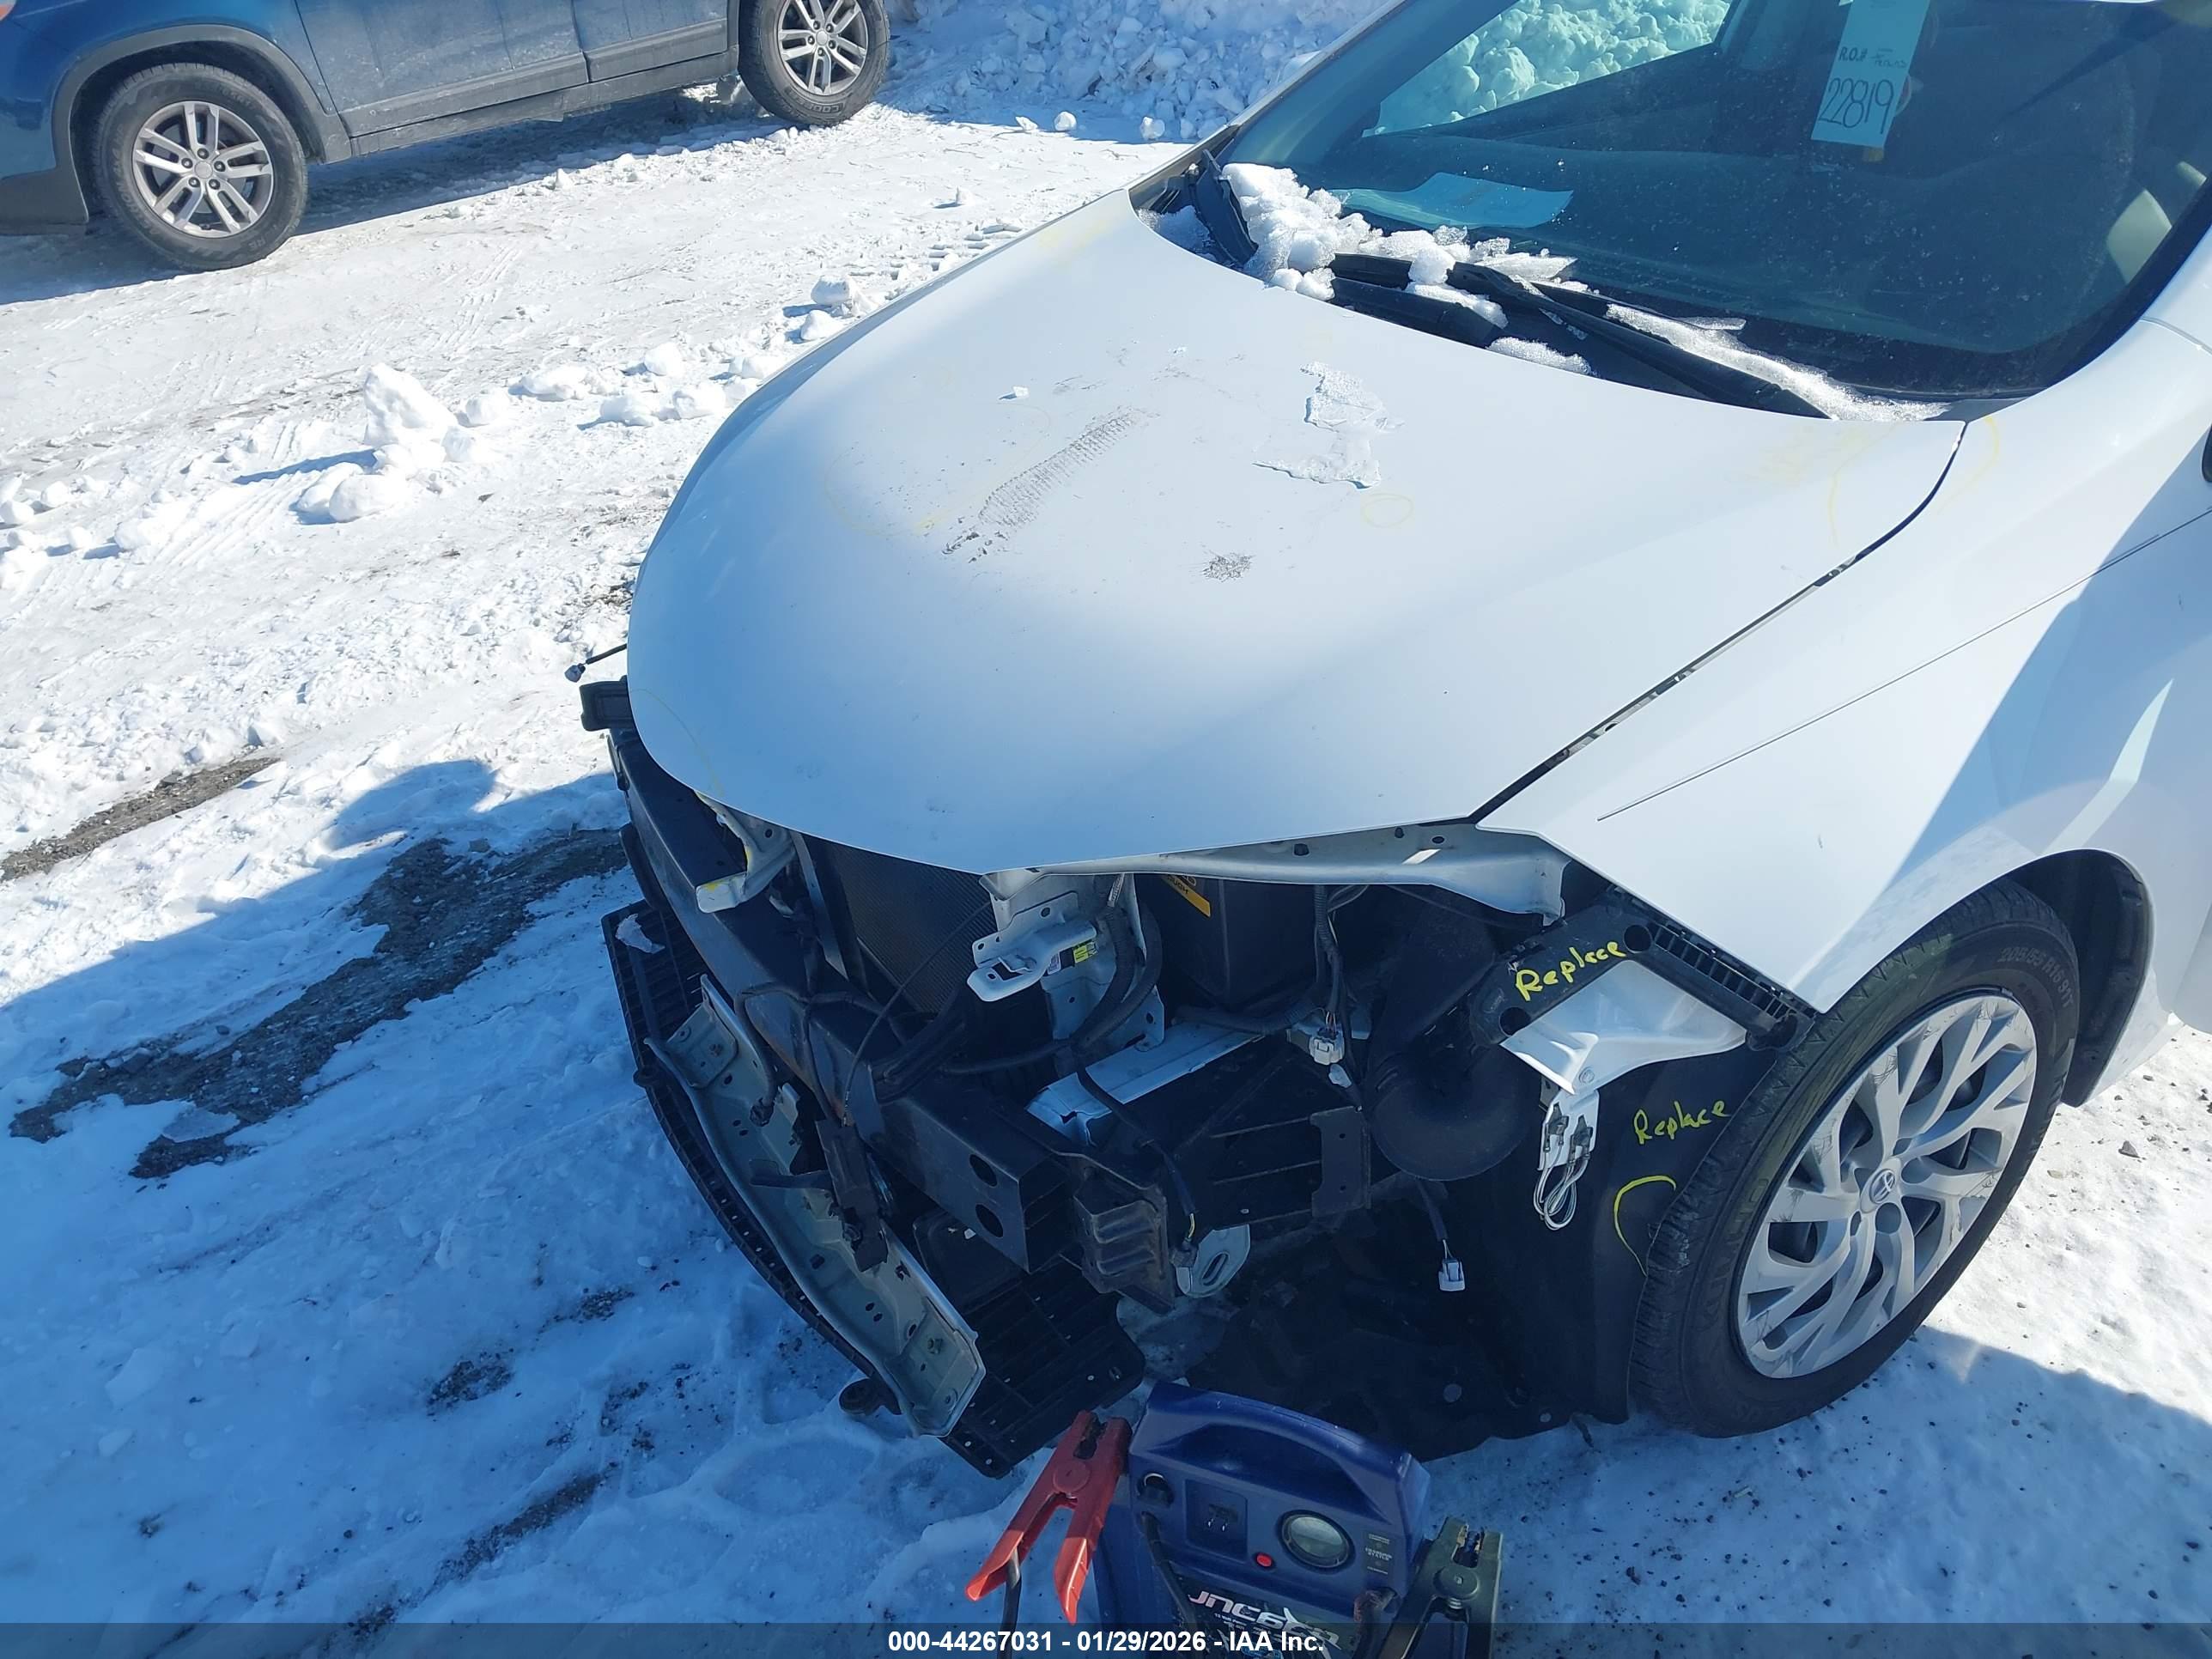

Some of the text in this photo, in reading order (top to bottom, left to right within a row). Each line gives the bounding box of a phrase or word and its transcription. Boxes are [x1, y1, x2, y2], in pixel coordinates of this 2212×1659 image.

[1818, 76, 1895, 135] 22819
[1515, 940, 1627, 1002] Replace
[1632, 1100, 1731, 1146] Replace
